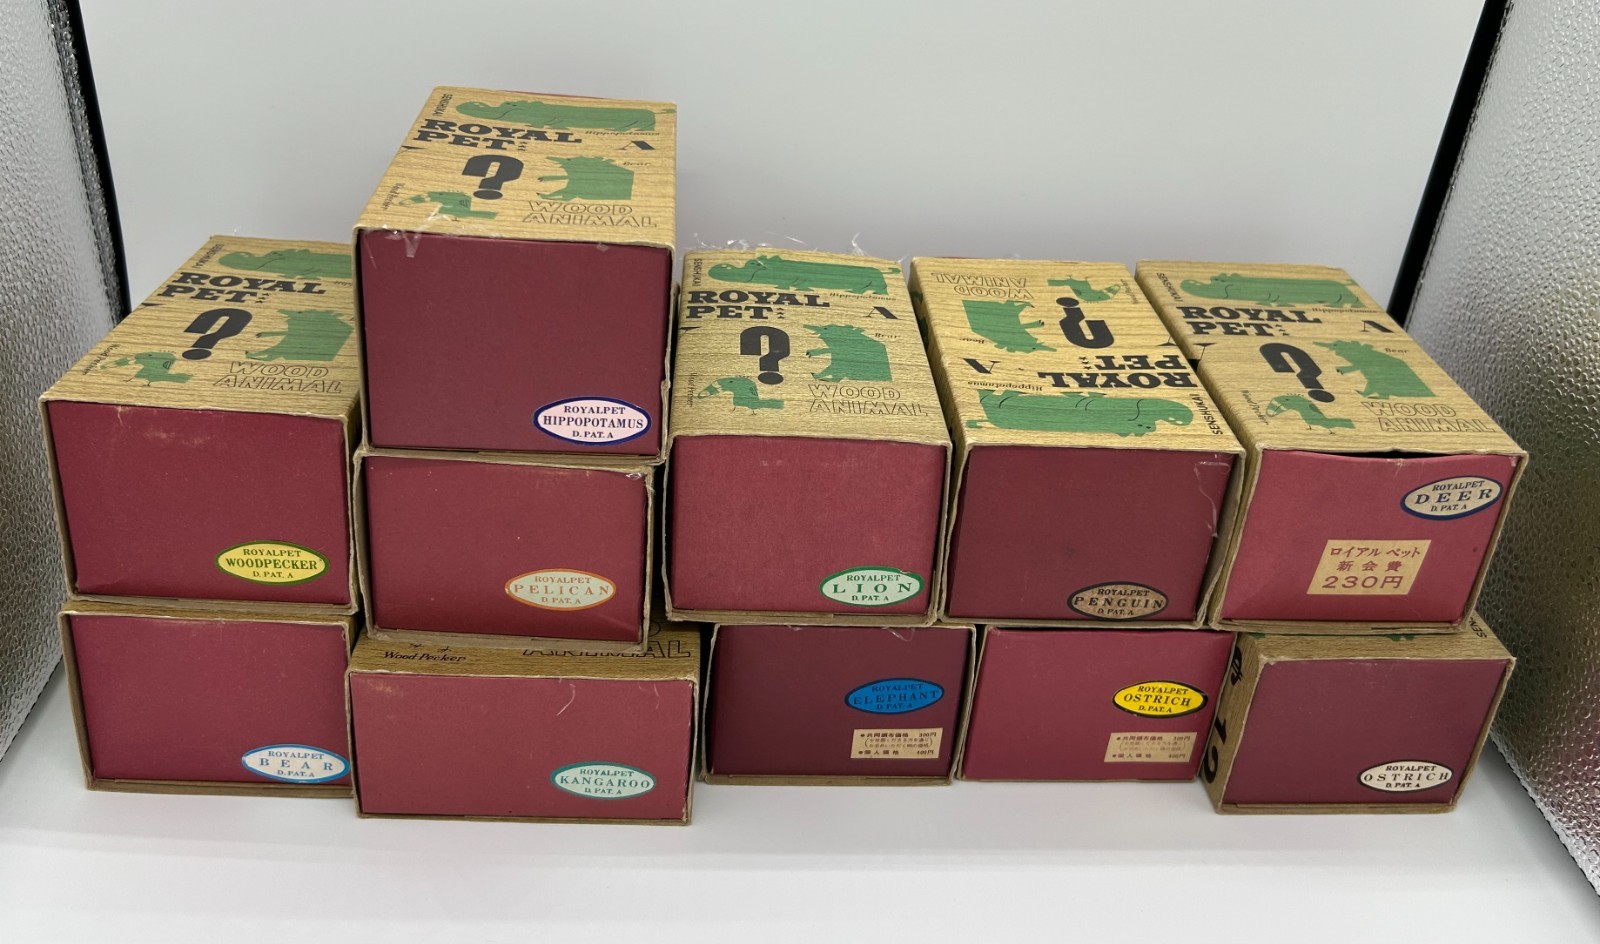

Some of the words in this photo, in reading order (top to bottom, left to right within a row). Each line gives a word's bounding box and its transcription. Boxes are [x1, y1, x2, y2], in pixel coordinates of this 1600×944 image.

[420, 118, 582, 144] ROYAL
[413, 129, 516, 151] PET
[528, 200, 633, 216] WOOD
[521, 212, 658, 228] ANIMAL
[172, 271, 327, 295] ROYAL
[931, 272, 1028, 288] ANIMAL
[157, 284, 259, 304] PET
[688, 289, 831, 308] ROYAL
[953, 285, 1035, 299] WOOD
[685, 305, 774, 320] PET
[1175, 305, 1322, 324] ROYAL
[1185, 321, 1276, 337] PET
[229, 361, 330, 378] WOOD
[1095, 354, 1187, 371] PET
[213, 375, 342, 394] ANIMAL
[967, 381, 1043, 392] Hippopotamus
[1037, 371, 1199, 389] ROYAL
[807, 383, 902, 400] WOOD
[564, 406, 626, 414] ROYALPET
[808, 399, 929, 417] ANIMAL
[1192, 392, 1224, 436] SENSHUKAI
[1360, 400, 1458, 418] WOOD
[543, 415, 644, 428] HIPPOPOTAMUS
[1375, 416, 1497, 433] ANIMAL
[1432, 480, 1486, 492] ROYALPET
[1414, 488, 1493, 505] DEER
[243, 549, 301, 557] ROYALPET
[1329, 546, 1382, 557] ロイアル
[226, 558, 317, 570] WOODPECKER
[535, 576, 591, 584] ROYALPET
[1322, 575, 1403, 590] 230円
[514, 584, 609, 595] PELICAN
[833, 583, 912, 593] LION
[1074, 597, 1164, 608] PENGUIN
[383, 650, 418, 661] Wood
[419, 652, 467, 662] Pecker
[872, 684, 923, 692] ROYALPET
[1138, 686, 1189, 695] ROYALPET
[854, 691, 939, 705] ELEPHANT
[1124, 693, 1192, 706] OSTRICH
[268, 751, 324, 760] ROYALPET
[260, 758, 333, 770] BEAR
[580, 769, 634, 777] ROYALPET
[1364, 773, 1448, 781] OSTRICH
[560, 776, 650, 788] KANGAROO
